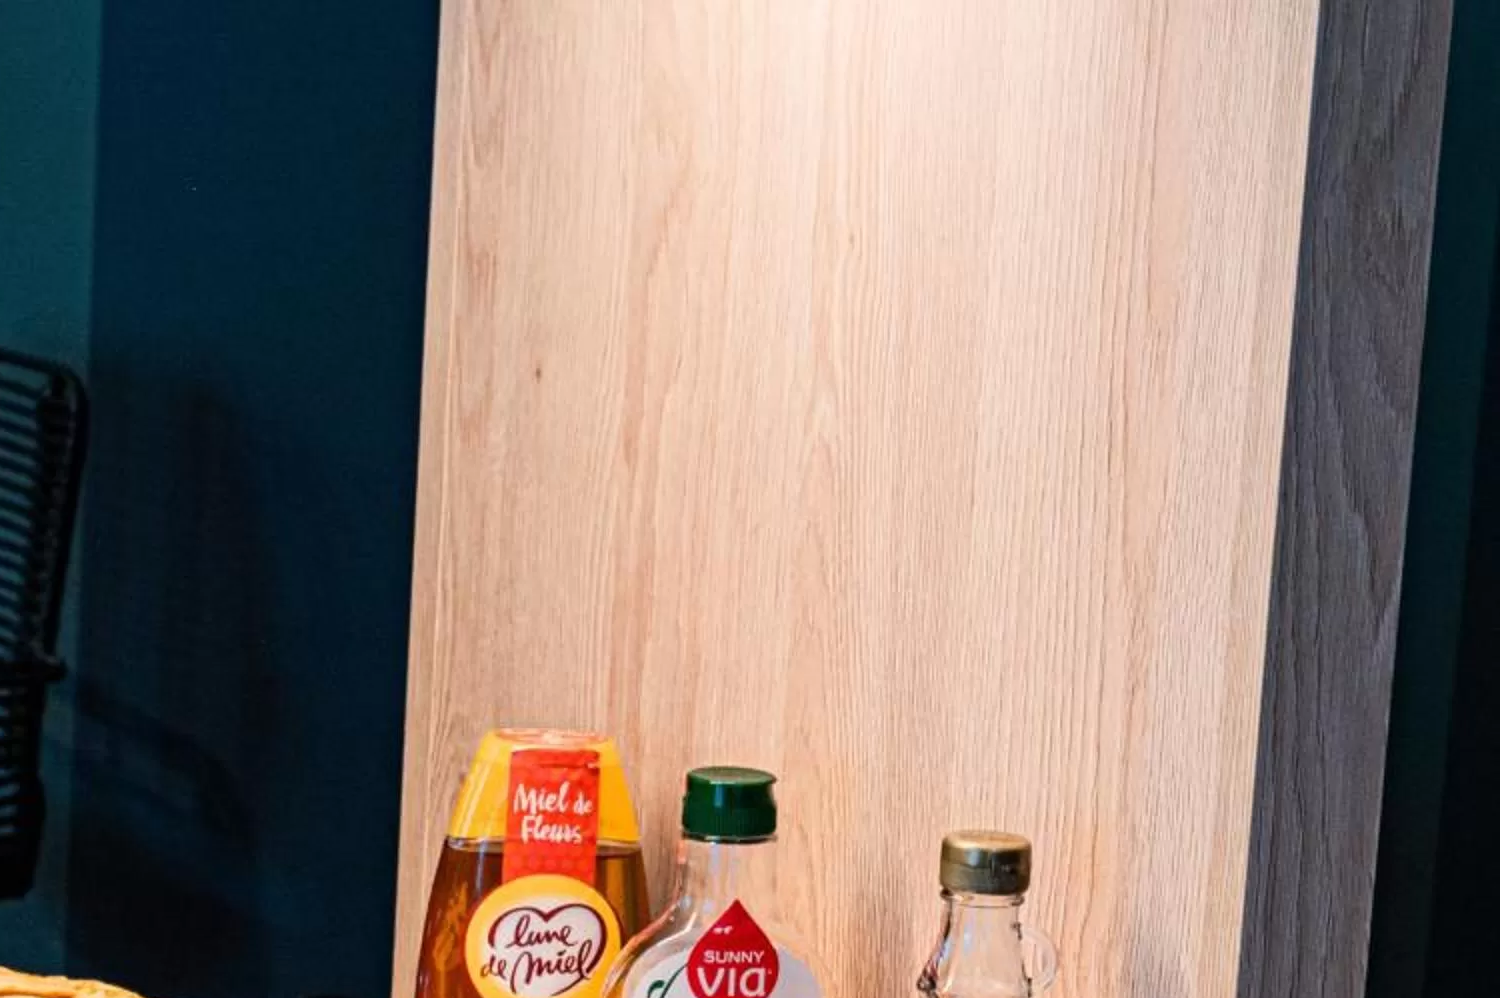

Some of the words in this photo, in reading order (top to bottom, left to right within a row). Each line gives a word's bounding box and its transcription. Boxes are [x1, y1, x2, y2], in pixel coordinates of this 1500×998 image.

[513, 781, 571, 816] Miel
[573, 791, 593, 815] de
[520, 815, 584, 845] Fleurs
[480, 955, 508, 980] de
[704, 950, 765, 964] SUNNY
